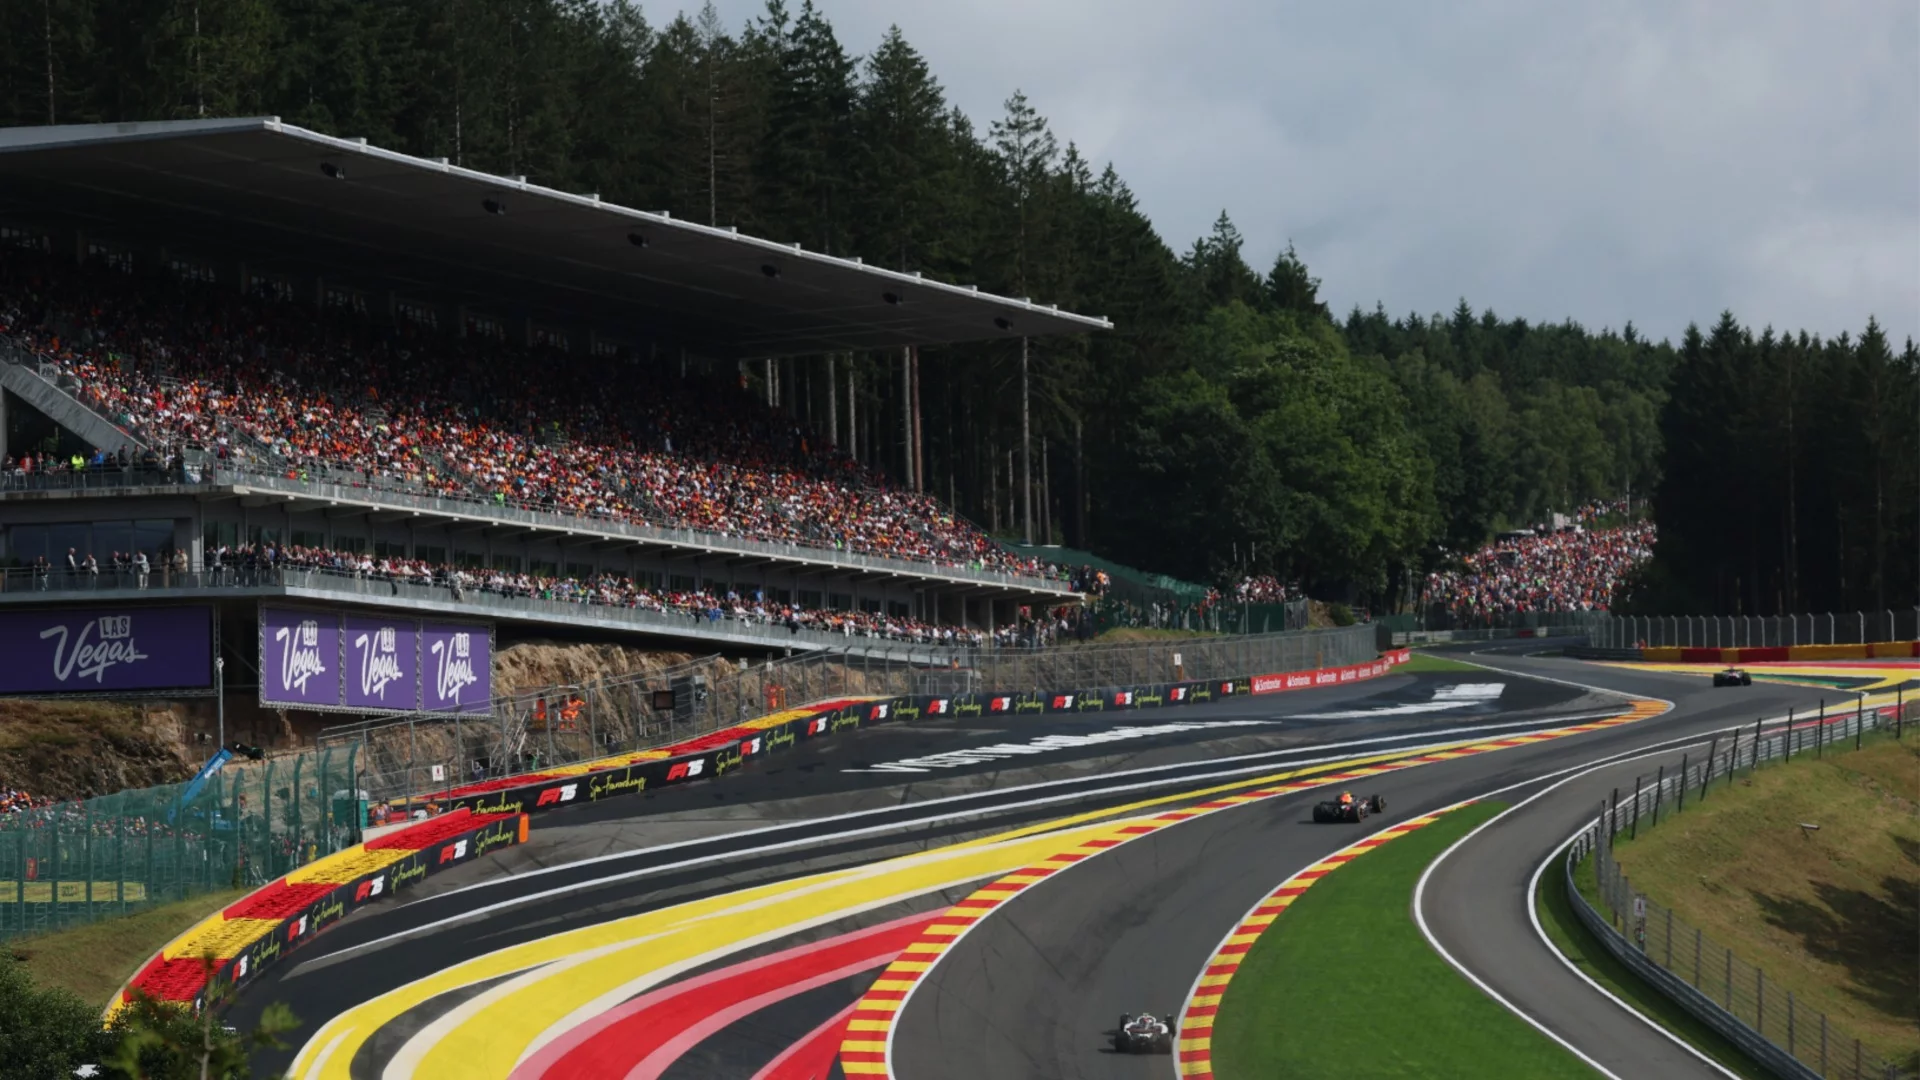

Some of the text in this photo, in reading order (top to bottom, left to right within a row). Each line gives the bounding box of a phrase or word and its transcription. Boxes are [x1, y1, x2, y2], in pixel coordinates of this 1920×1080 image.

[40, 620, 148, 683] Vegas
[99, 616, 131, 639] LAS
[276, 624, 326, 696] Vegas
[355, 630, 403, 701] Vegas
[431, 636, 477, 705] Vegas
